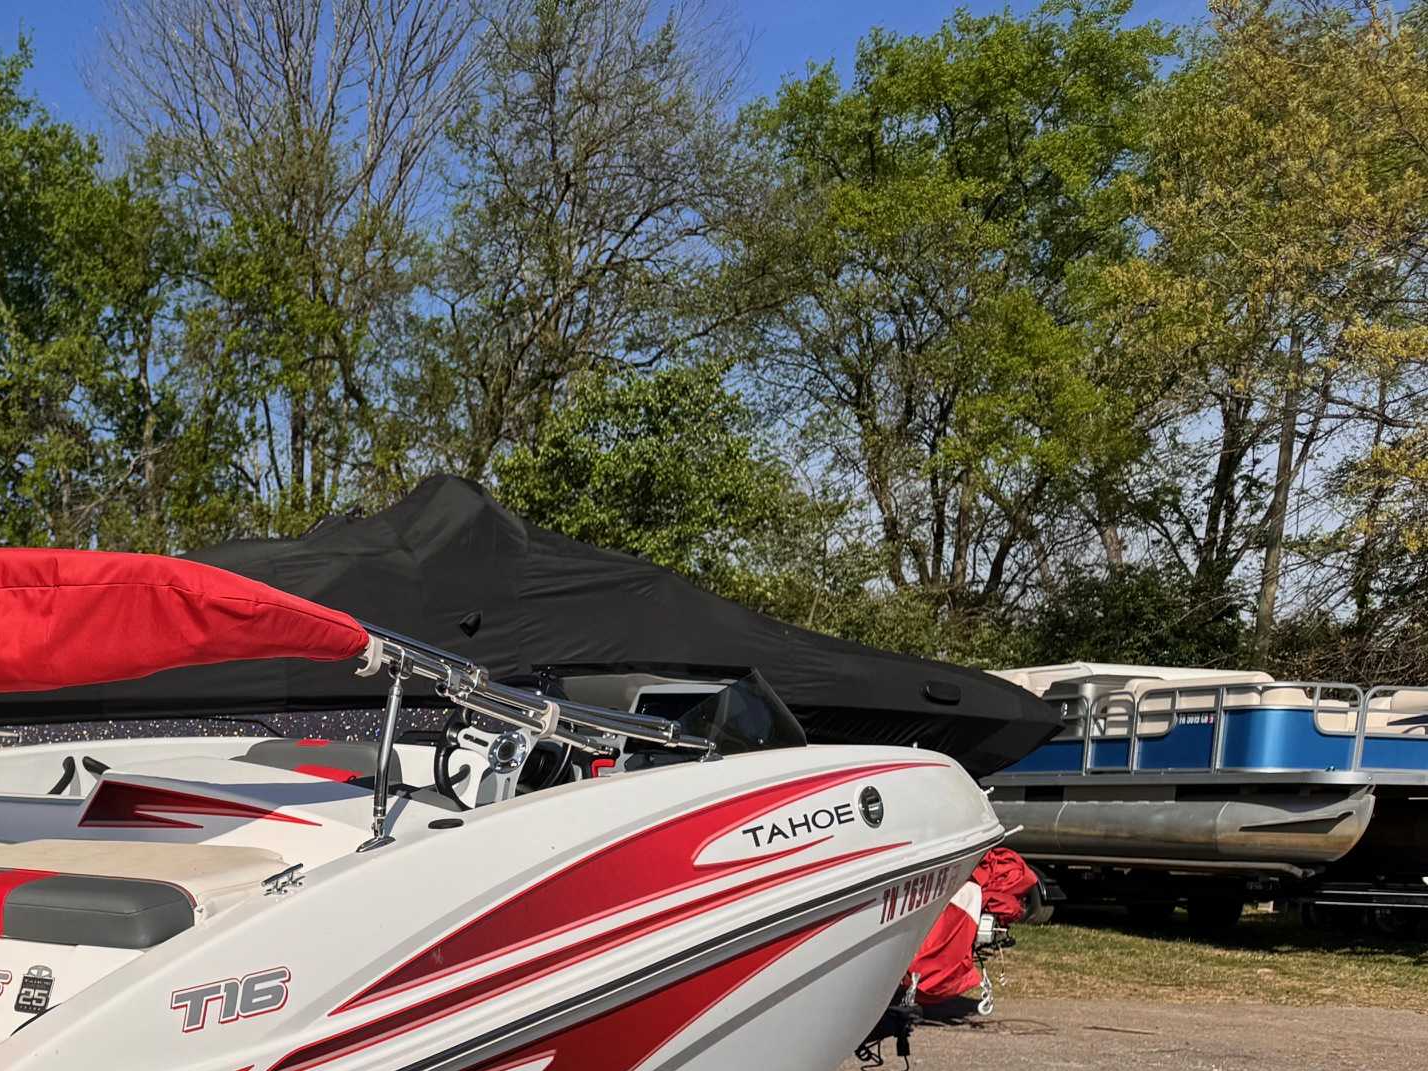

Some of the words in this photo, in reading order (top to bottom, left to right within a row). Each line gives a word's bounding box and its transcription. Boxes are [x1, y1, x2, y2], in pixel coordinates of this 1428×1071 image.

[742, 803, 855, 848] TAHOE
[19, 988, 48, 1007] 25
[171, 966, 292, 1033] T16
